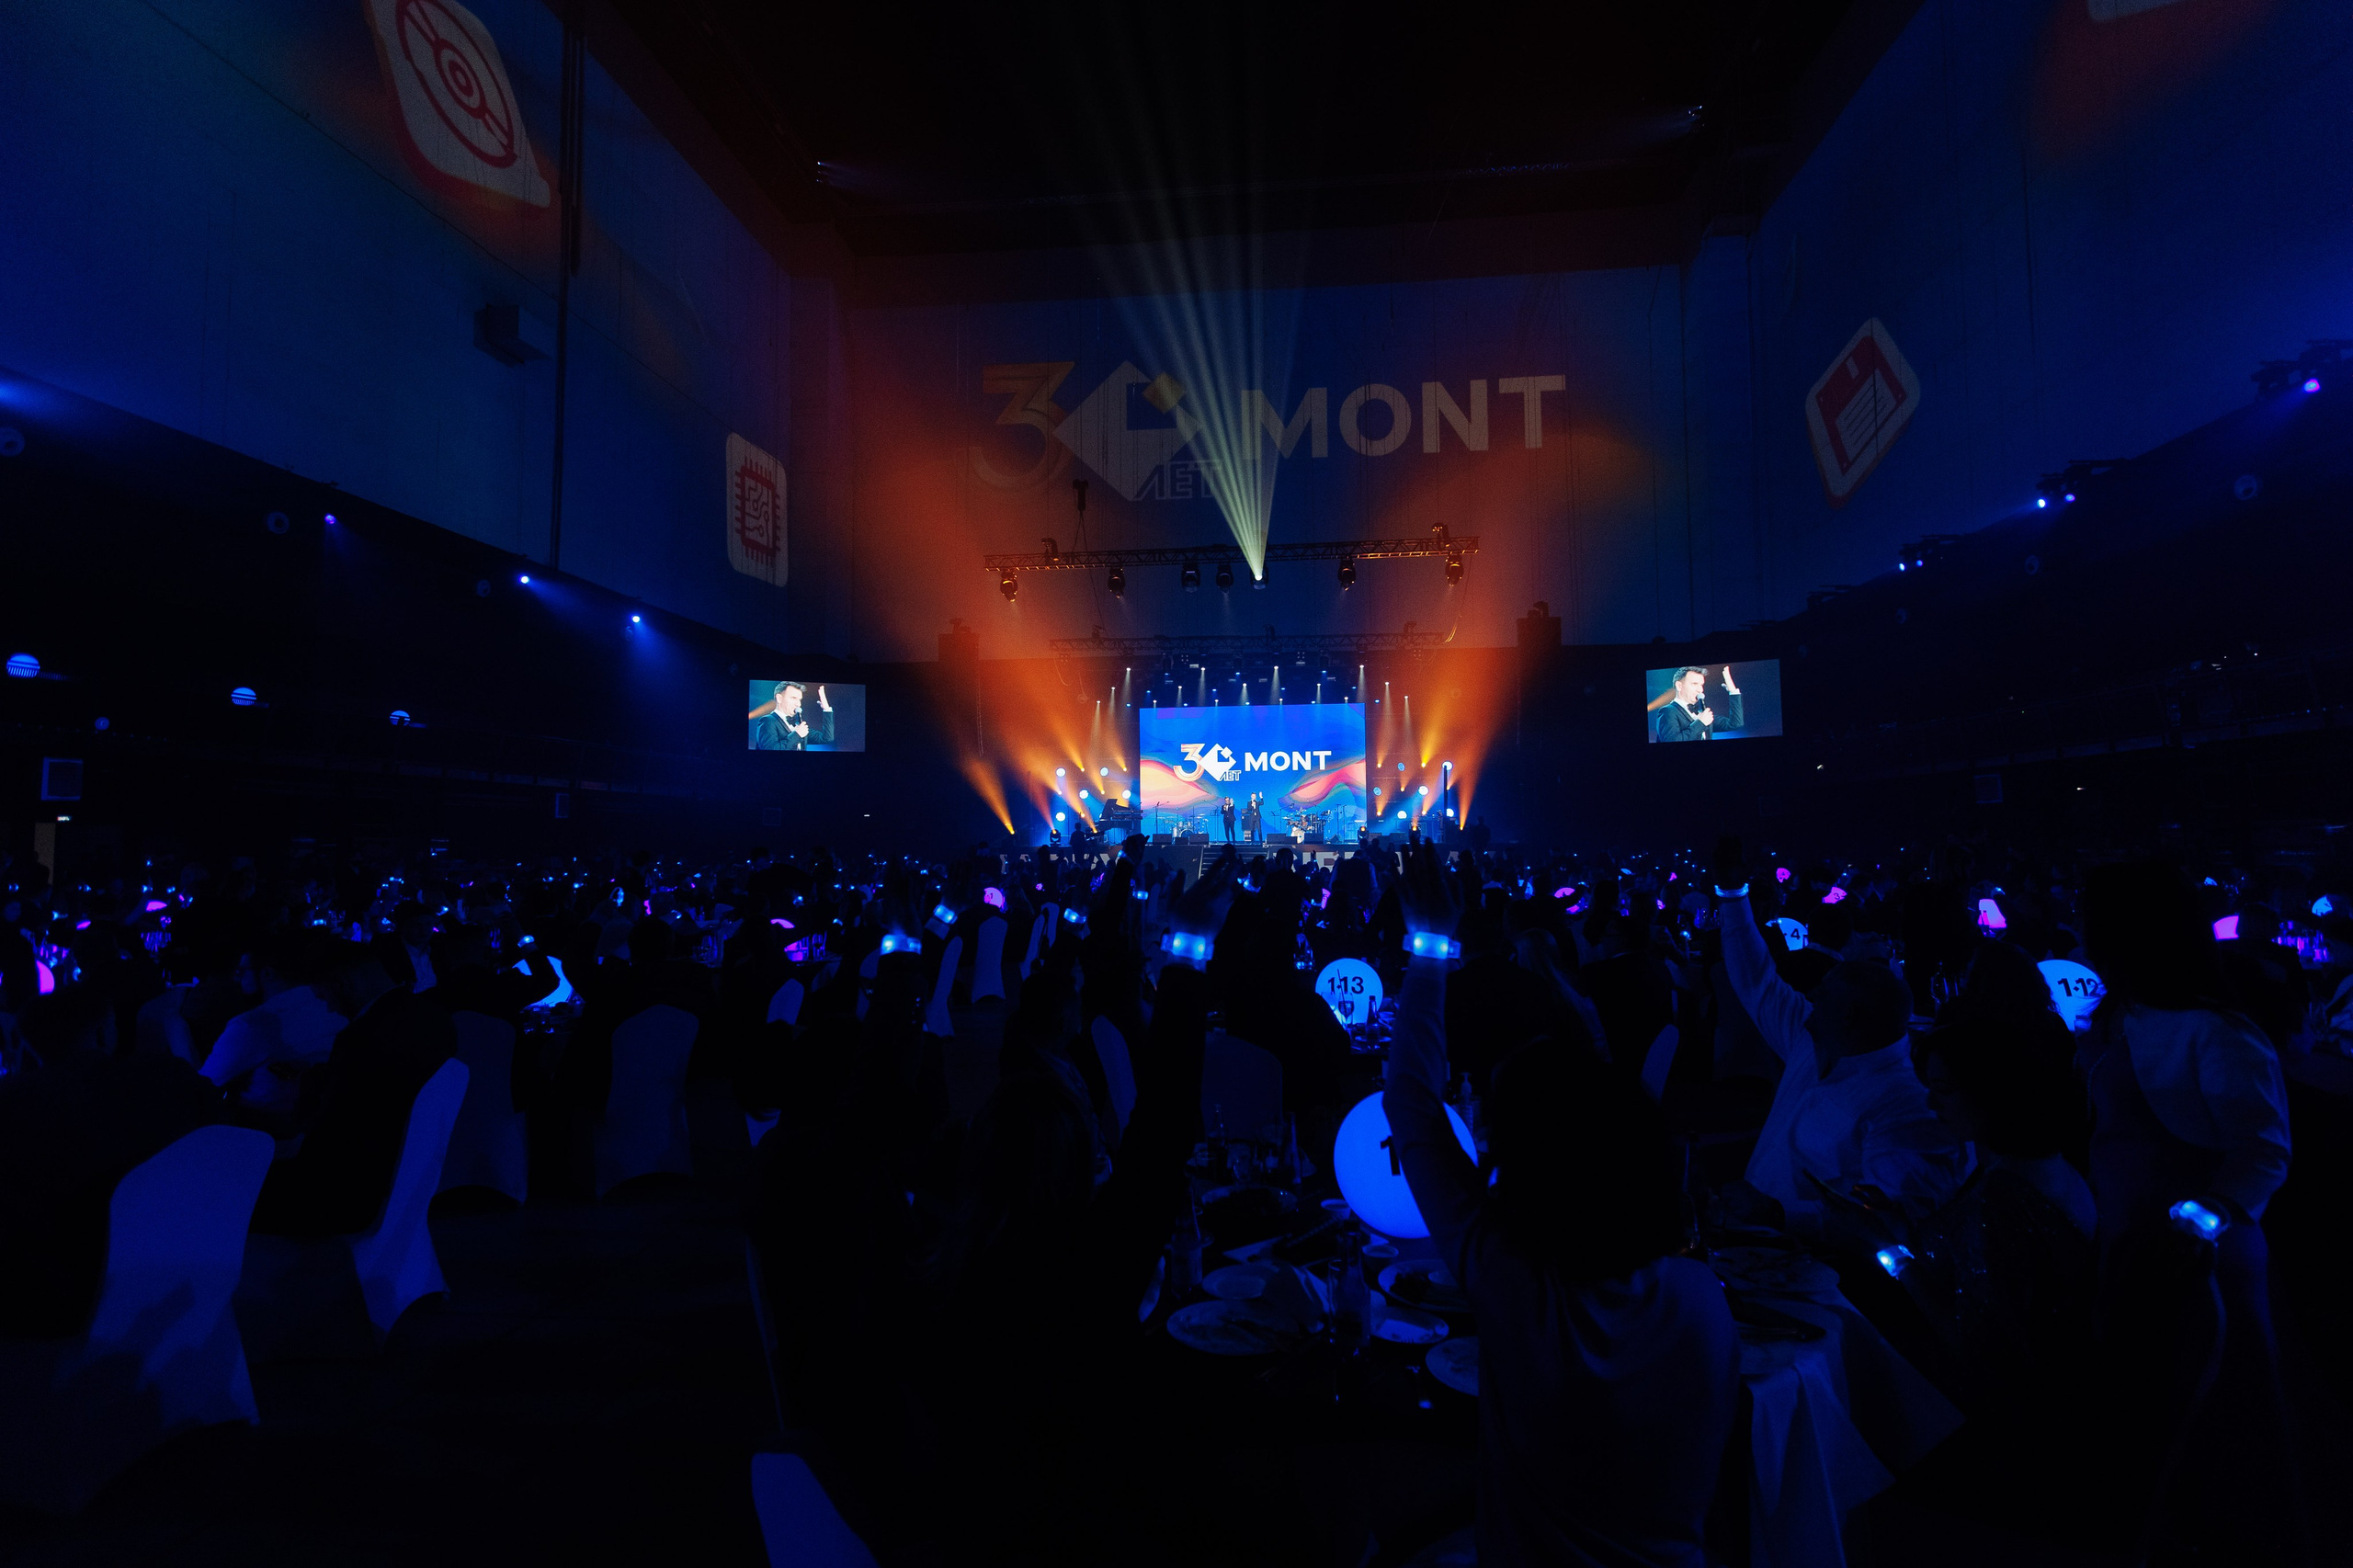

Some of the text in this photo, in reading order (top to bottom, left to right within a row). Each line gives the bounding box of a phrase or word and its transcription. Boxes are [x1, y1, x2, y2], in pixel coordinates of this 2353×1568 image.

[1241, 374, 1566, 460] MONT
[1219, 769, 1242, 781] ЛЕТ
[1245, 750, 1332, 771] MONT
[1380, 1135, 1402, 1176] 1
